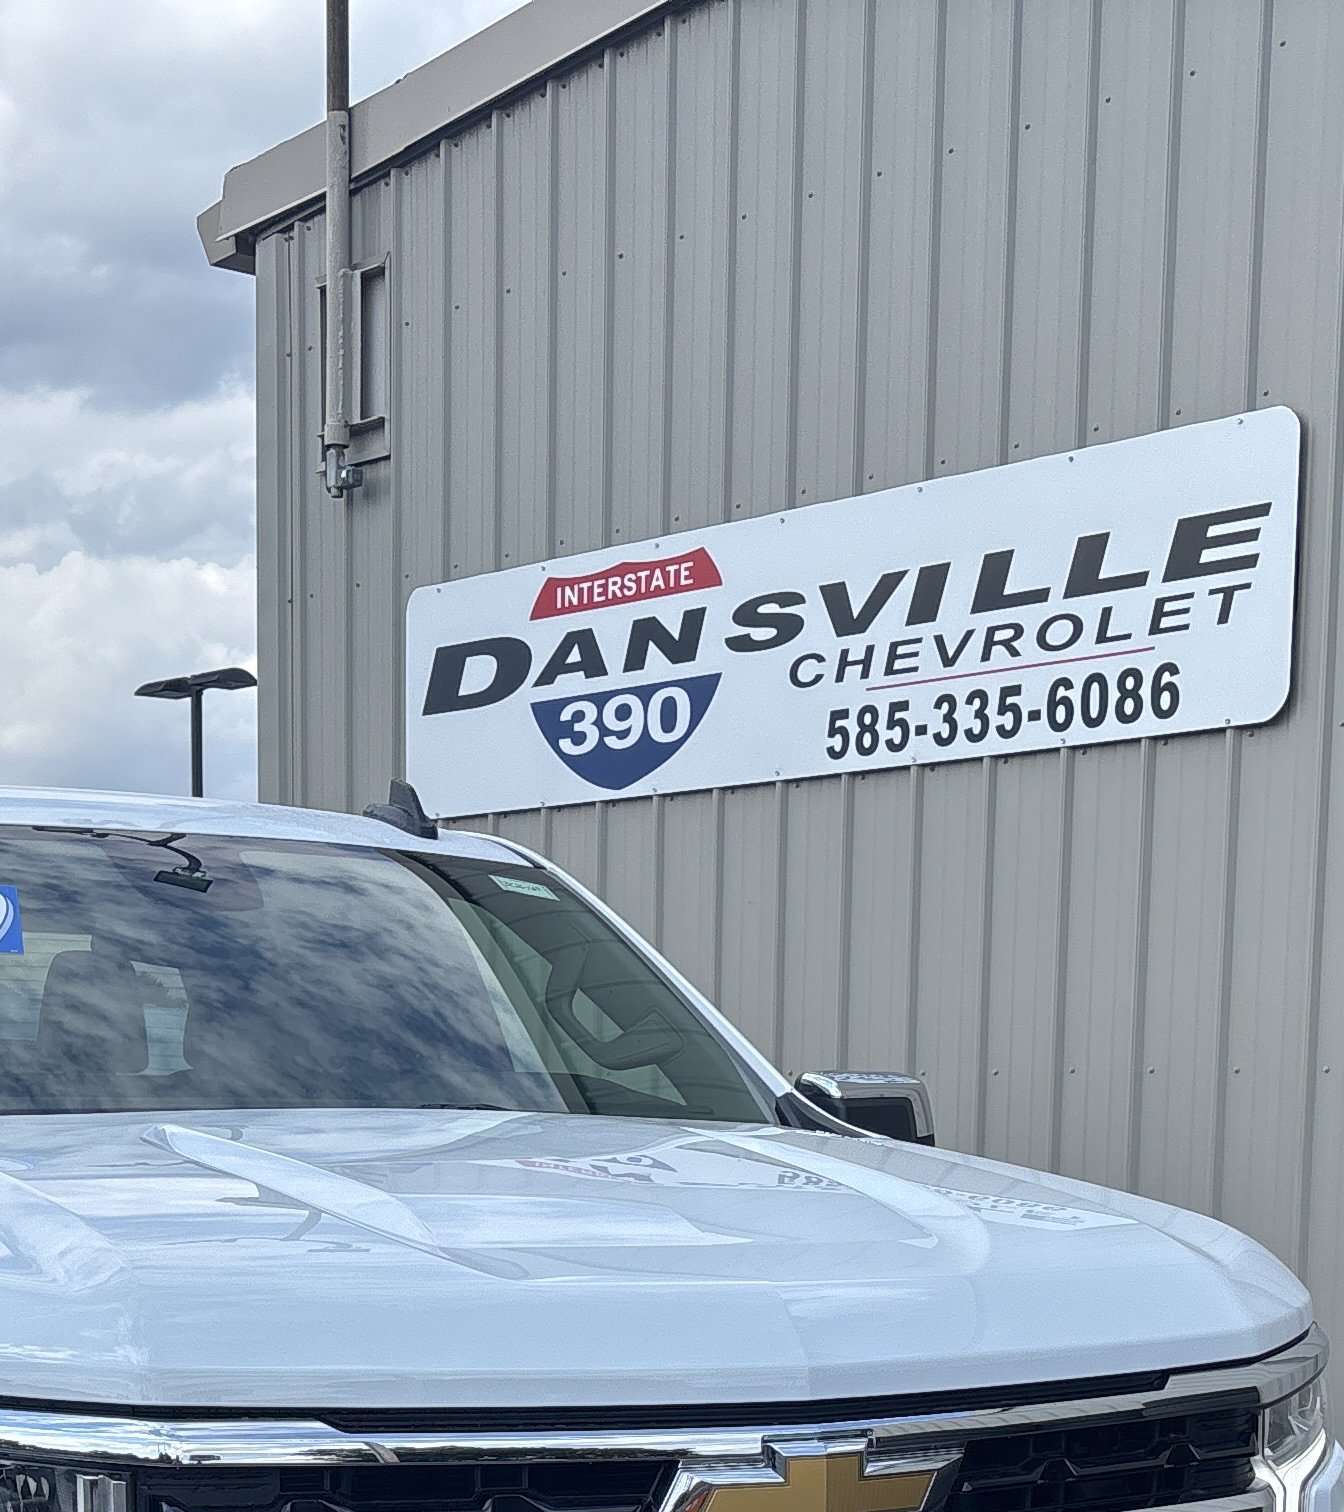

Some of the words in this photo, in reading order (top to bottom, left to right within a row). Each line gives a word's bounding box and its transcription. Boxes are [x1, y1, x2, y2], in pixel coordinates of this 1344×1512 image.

[421, 501, 1273, 717] DANSVILLE
[555, 560, 695, 610] INTERSTATE
[788, 582, 1253, 690] CHEVROLET
[557, 685, 692, 757] 390
[825, 661, 1181, 762] 585-335-6086
